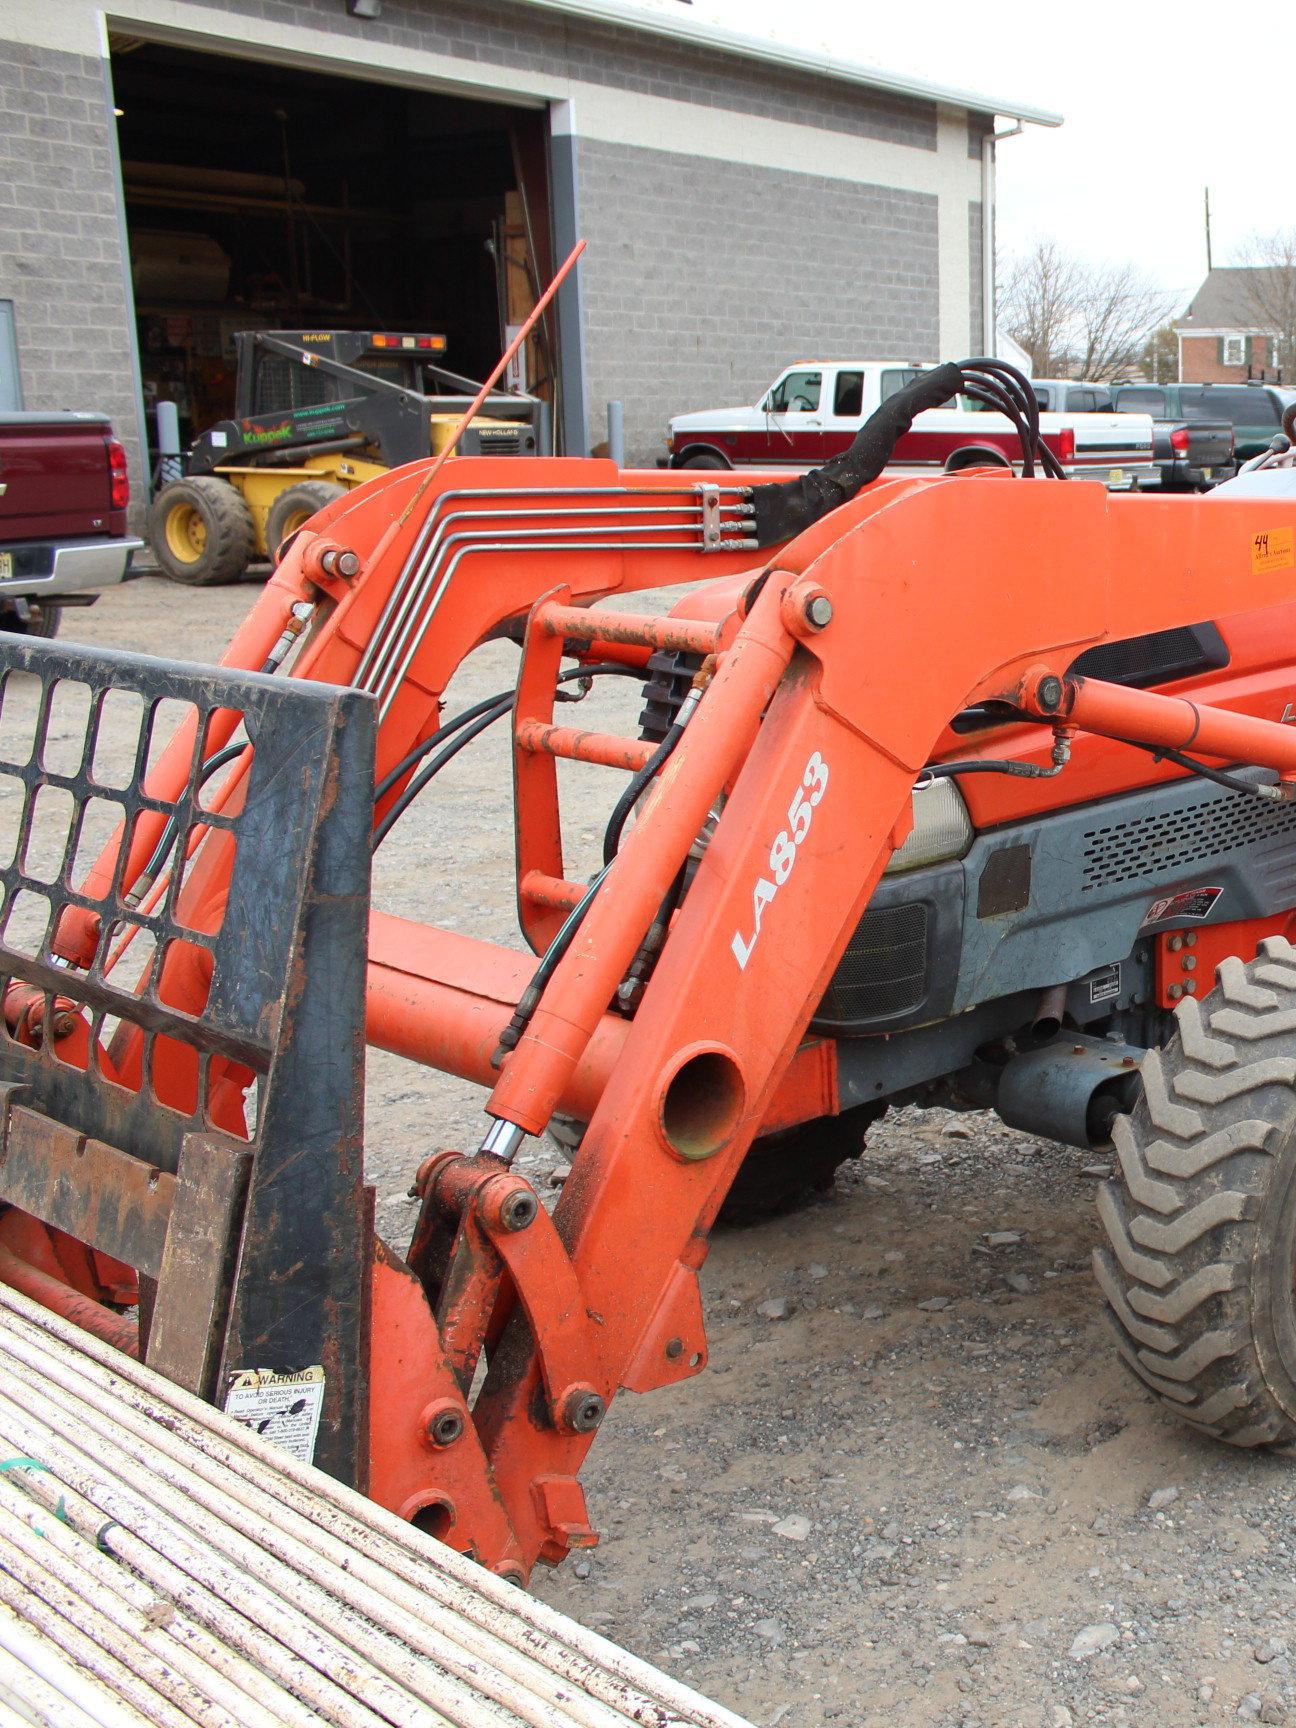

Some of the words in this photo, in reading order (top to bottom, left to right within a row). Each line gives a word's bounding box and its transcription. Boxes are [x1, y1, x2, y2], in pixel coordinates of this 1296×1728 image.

[303, 334, 331, 342] HI-FLOW
[1255, 534, 1268, 555] 44
[730, 751, 829, 971] LA853
[258, 1372, 313, 1384] WARNING
[266, 1388, 292, 1397] SERIOUS
[294, 1387, 315, 1395] INJURY
